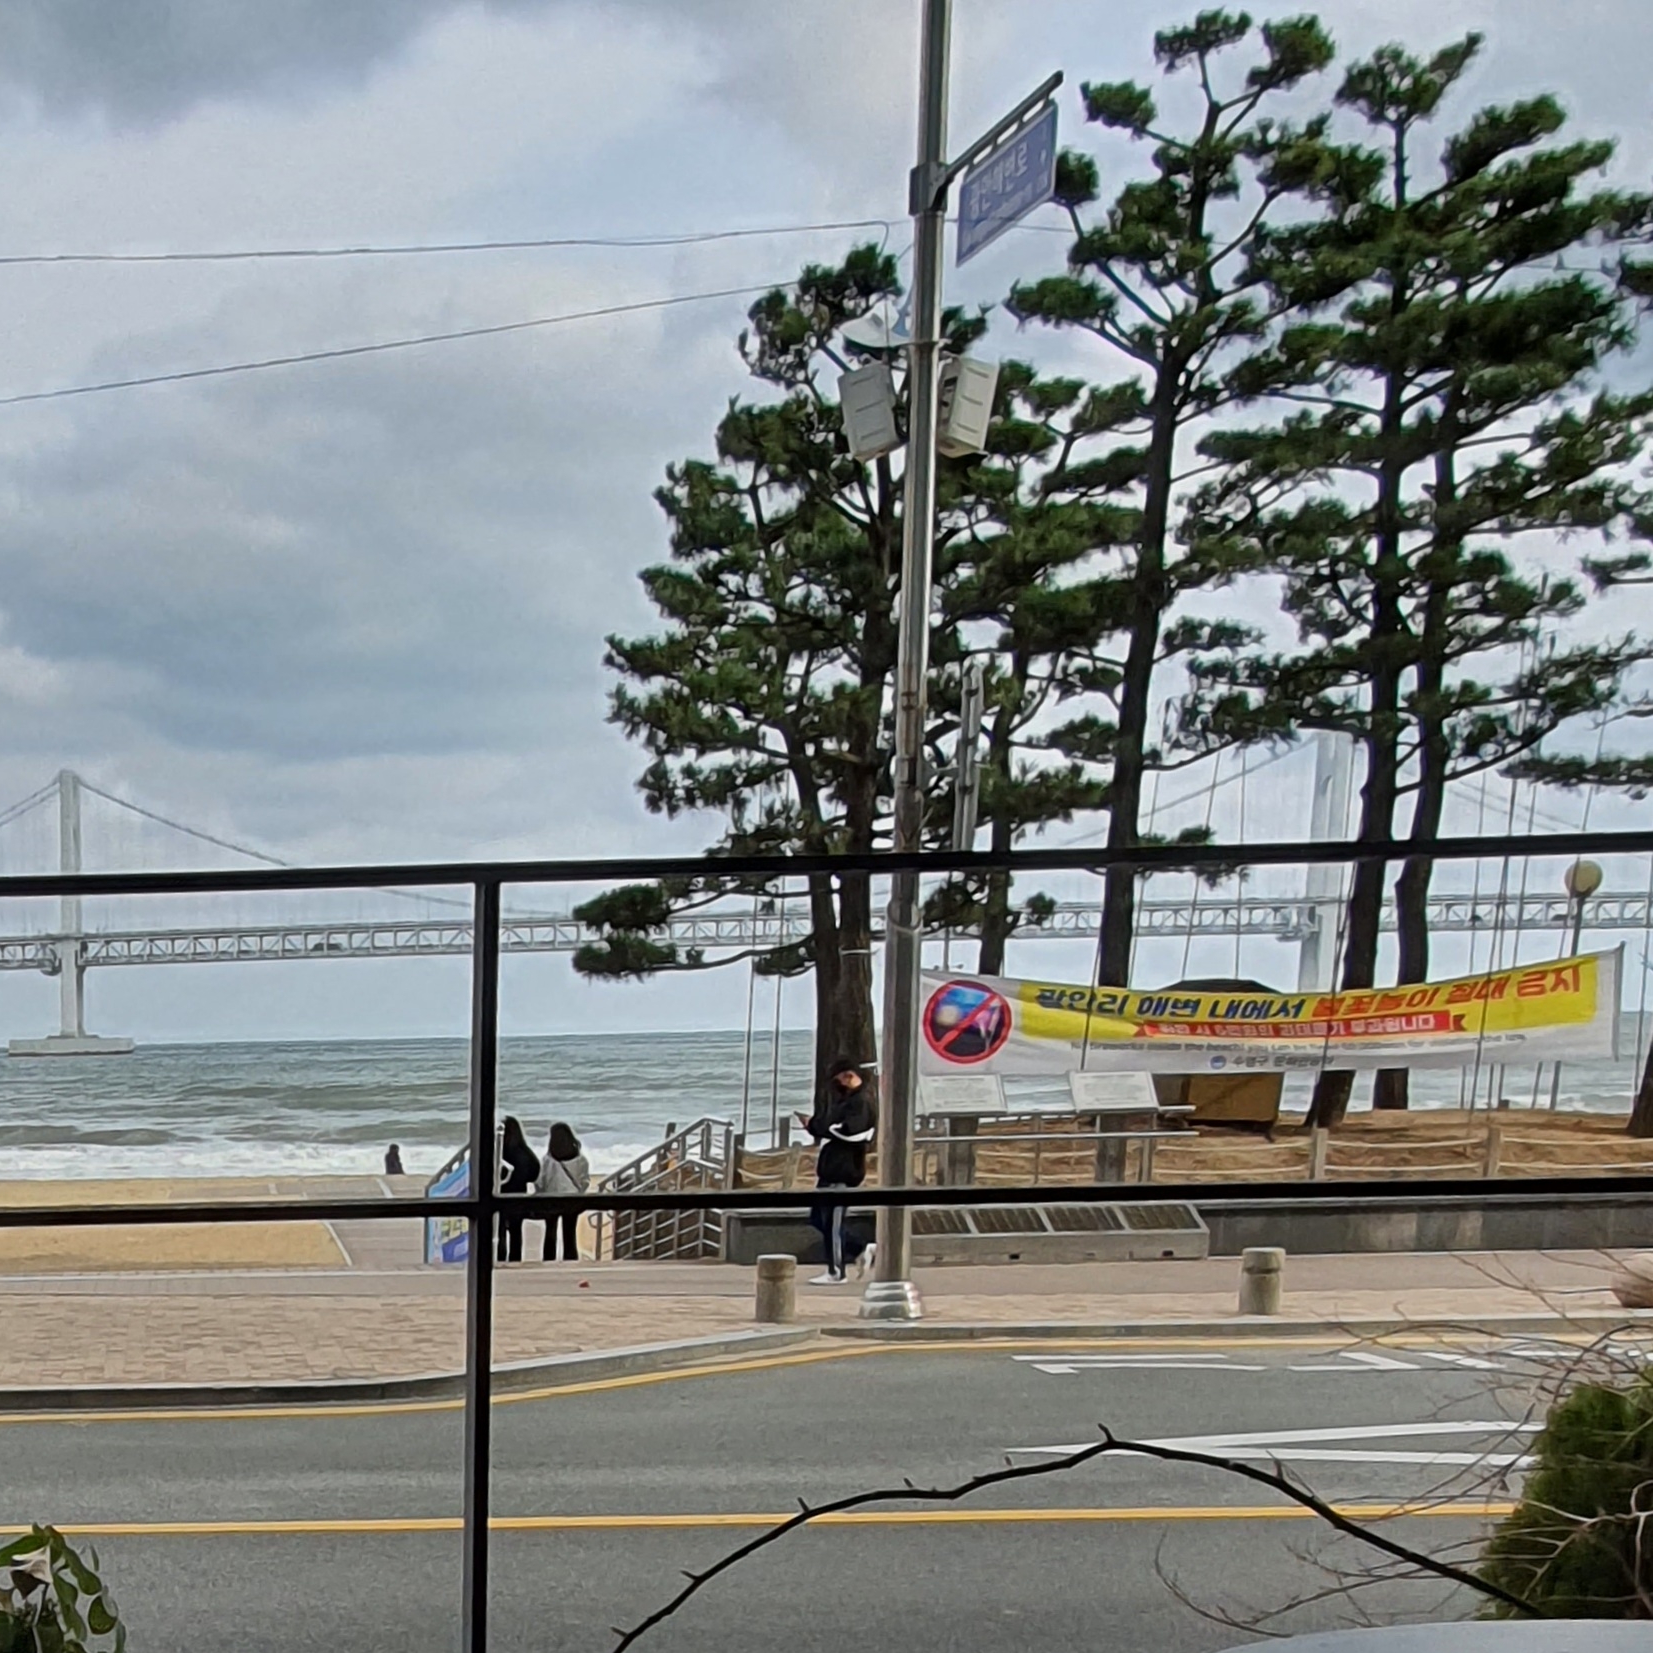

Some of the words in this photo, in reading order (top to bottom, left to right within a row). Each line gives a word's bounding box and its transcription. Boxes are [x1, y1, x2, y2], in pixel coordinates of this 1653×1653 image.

[1035, 988, 1130, 1016] 광안리
[1208, 997, 1305, 1020] 내에서
[1446, 974, 1510, 1004] 절대
[1517, 965, 1580, 997] 금지
